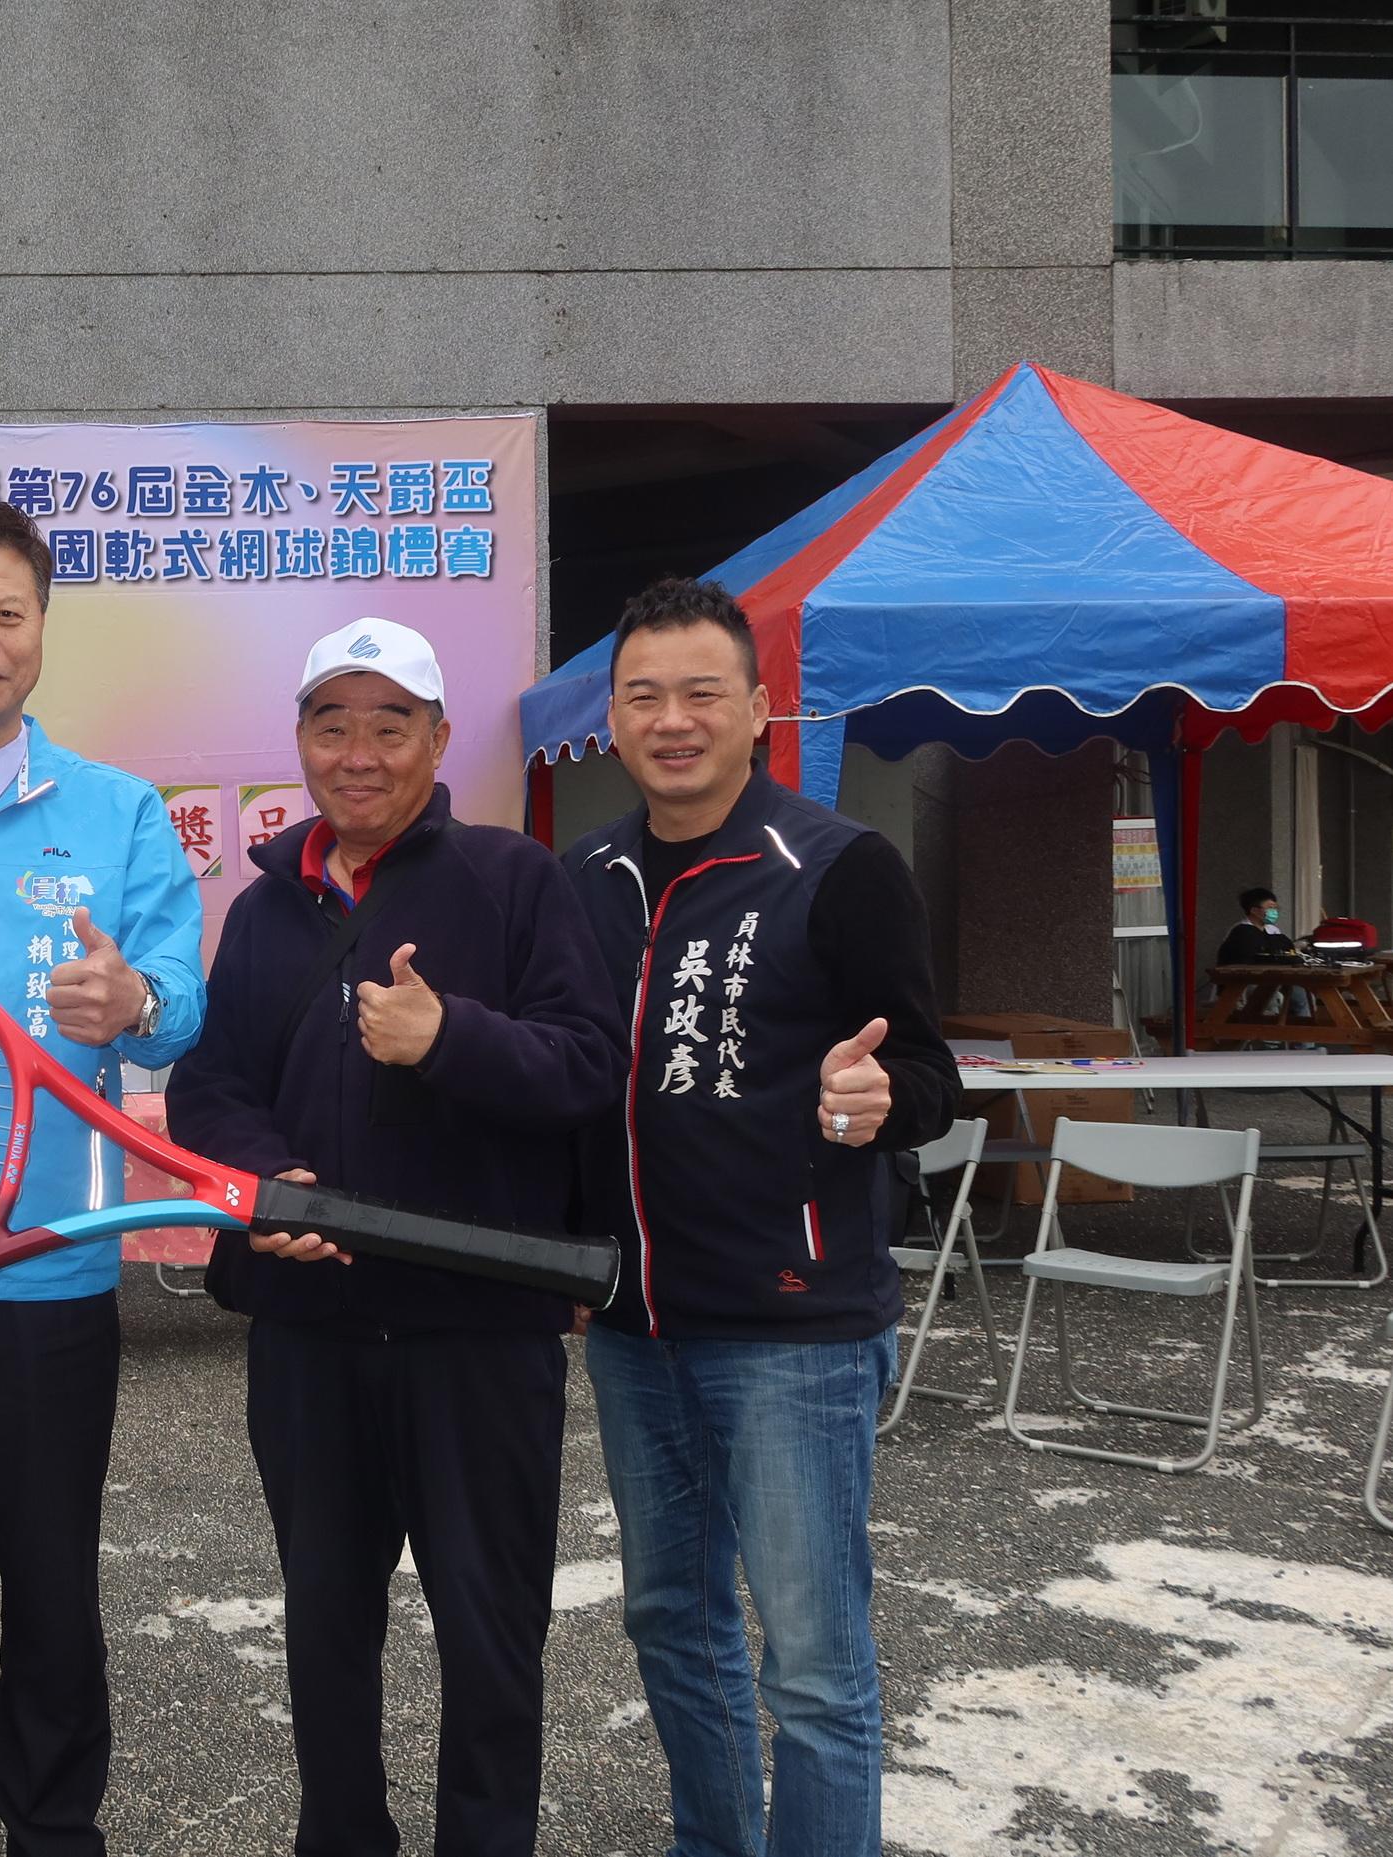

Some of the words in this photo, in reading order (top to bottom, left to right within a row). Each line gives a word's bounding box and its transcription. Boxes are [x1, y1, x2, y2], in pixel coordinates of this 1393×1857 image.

[49, 524, 493, 582] 國軟式網球錦標賽
[43, 848, 71, 858] FILA
[26, 934, 54, 1038] 賴致富
[657, 939, 713, 1095] 吳政彥
[713, 911, 759, 1099] 員林市民代表
[10, 1122, 27, 1160] YONEX
